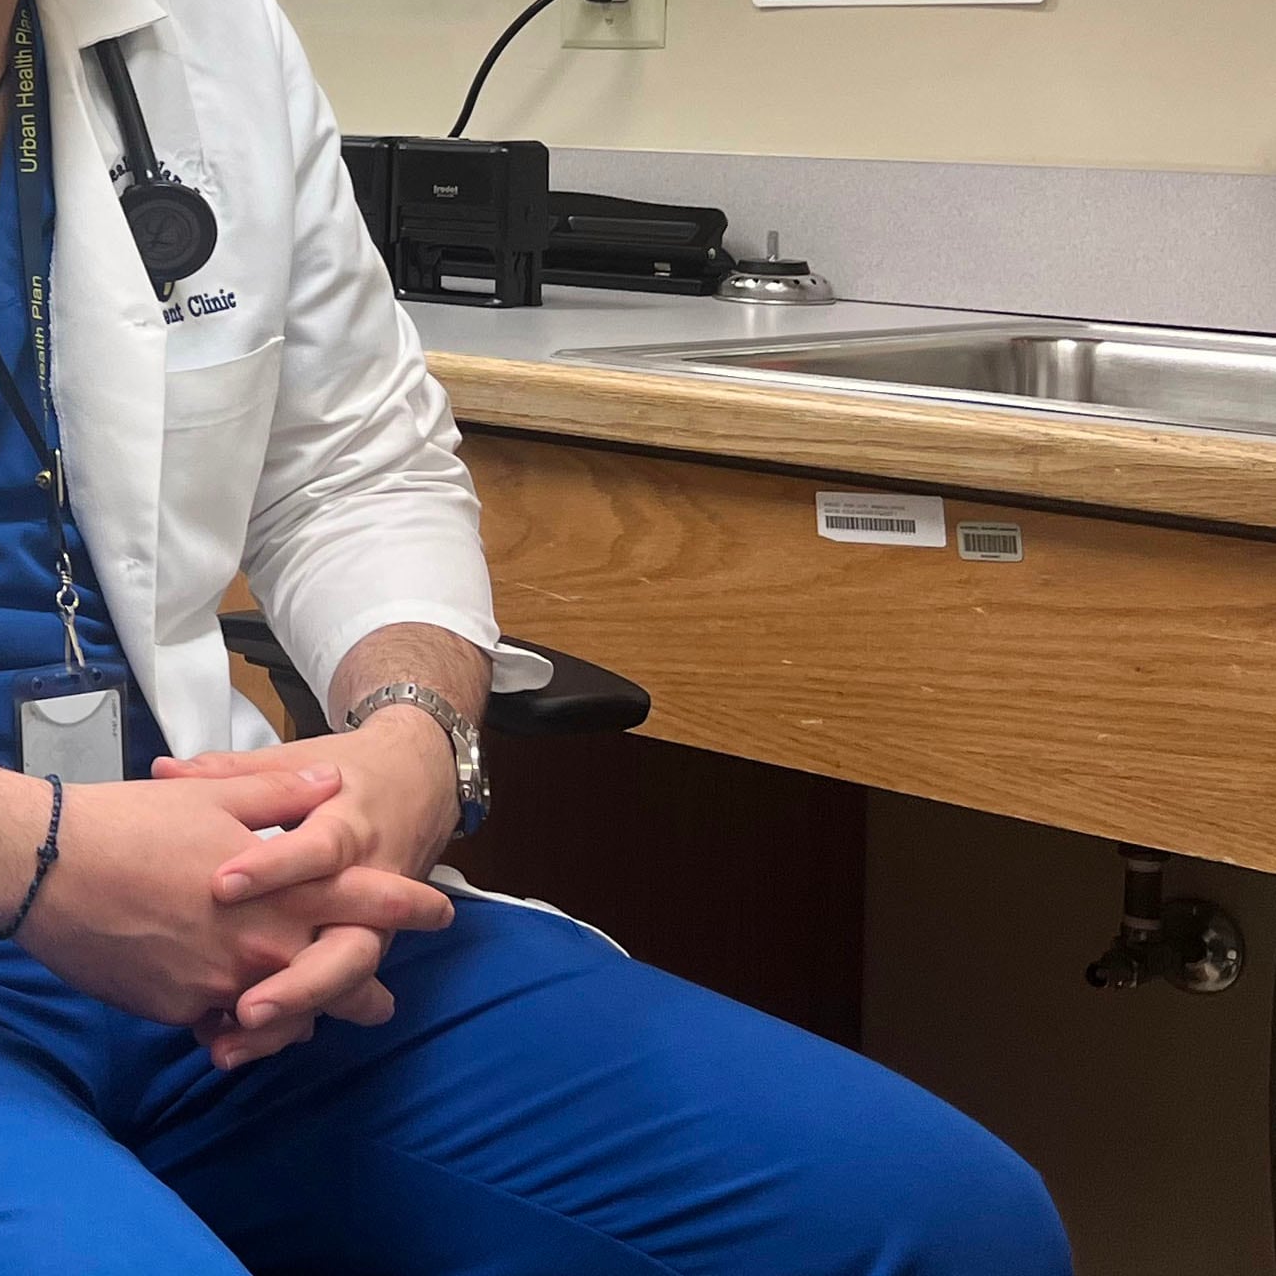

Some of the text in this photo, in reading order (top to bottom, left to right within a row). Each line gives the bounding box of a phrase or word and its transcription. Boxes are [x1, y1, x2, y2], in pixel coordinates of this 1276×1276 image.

[14, 48, 35, 108] Health
[19, 114, 37, 173] Urban
[30, 276, 43, 320] Plan
[163, 288, 237, 324] ent Clinic
